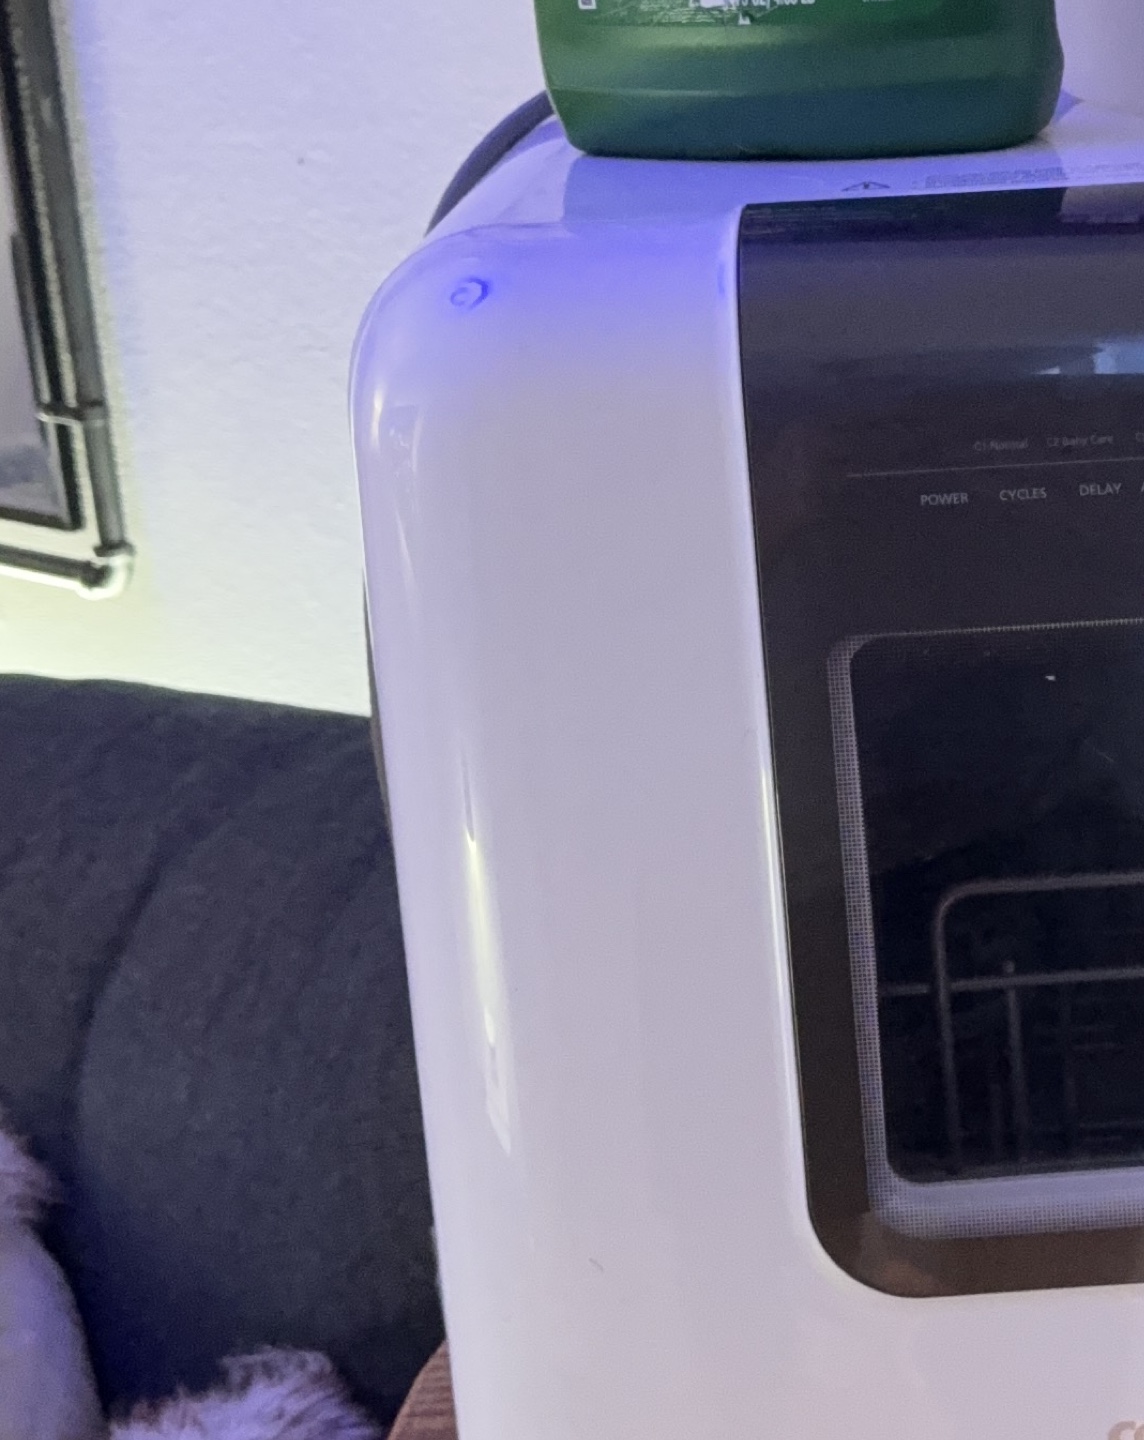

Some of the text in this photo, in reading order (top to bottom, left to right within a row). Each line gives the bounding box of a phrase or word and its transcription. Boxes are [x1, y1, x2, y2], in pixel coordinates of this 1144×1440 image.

[999, 487, 1048, 501] CYCLES
[1079, 482, 1123, 496] DELAY
[920, 493, 969, 506] POWER
